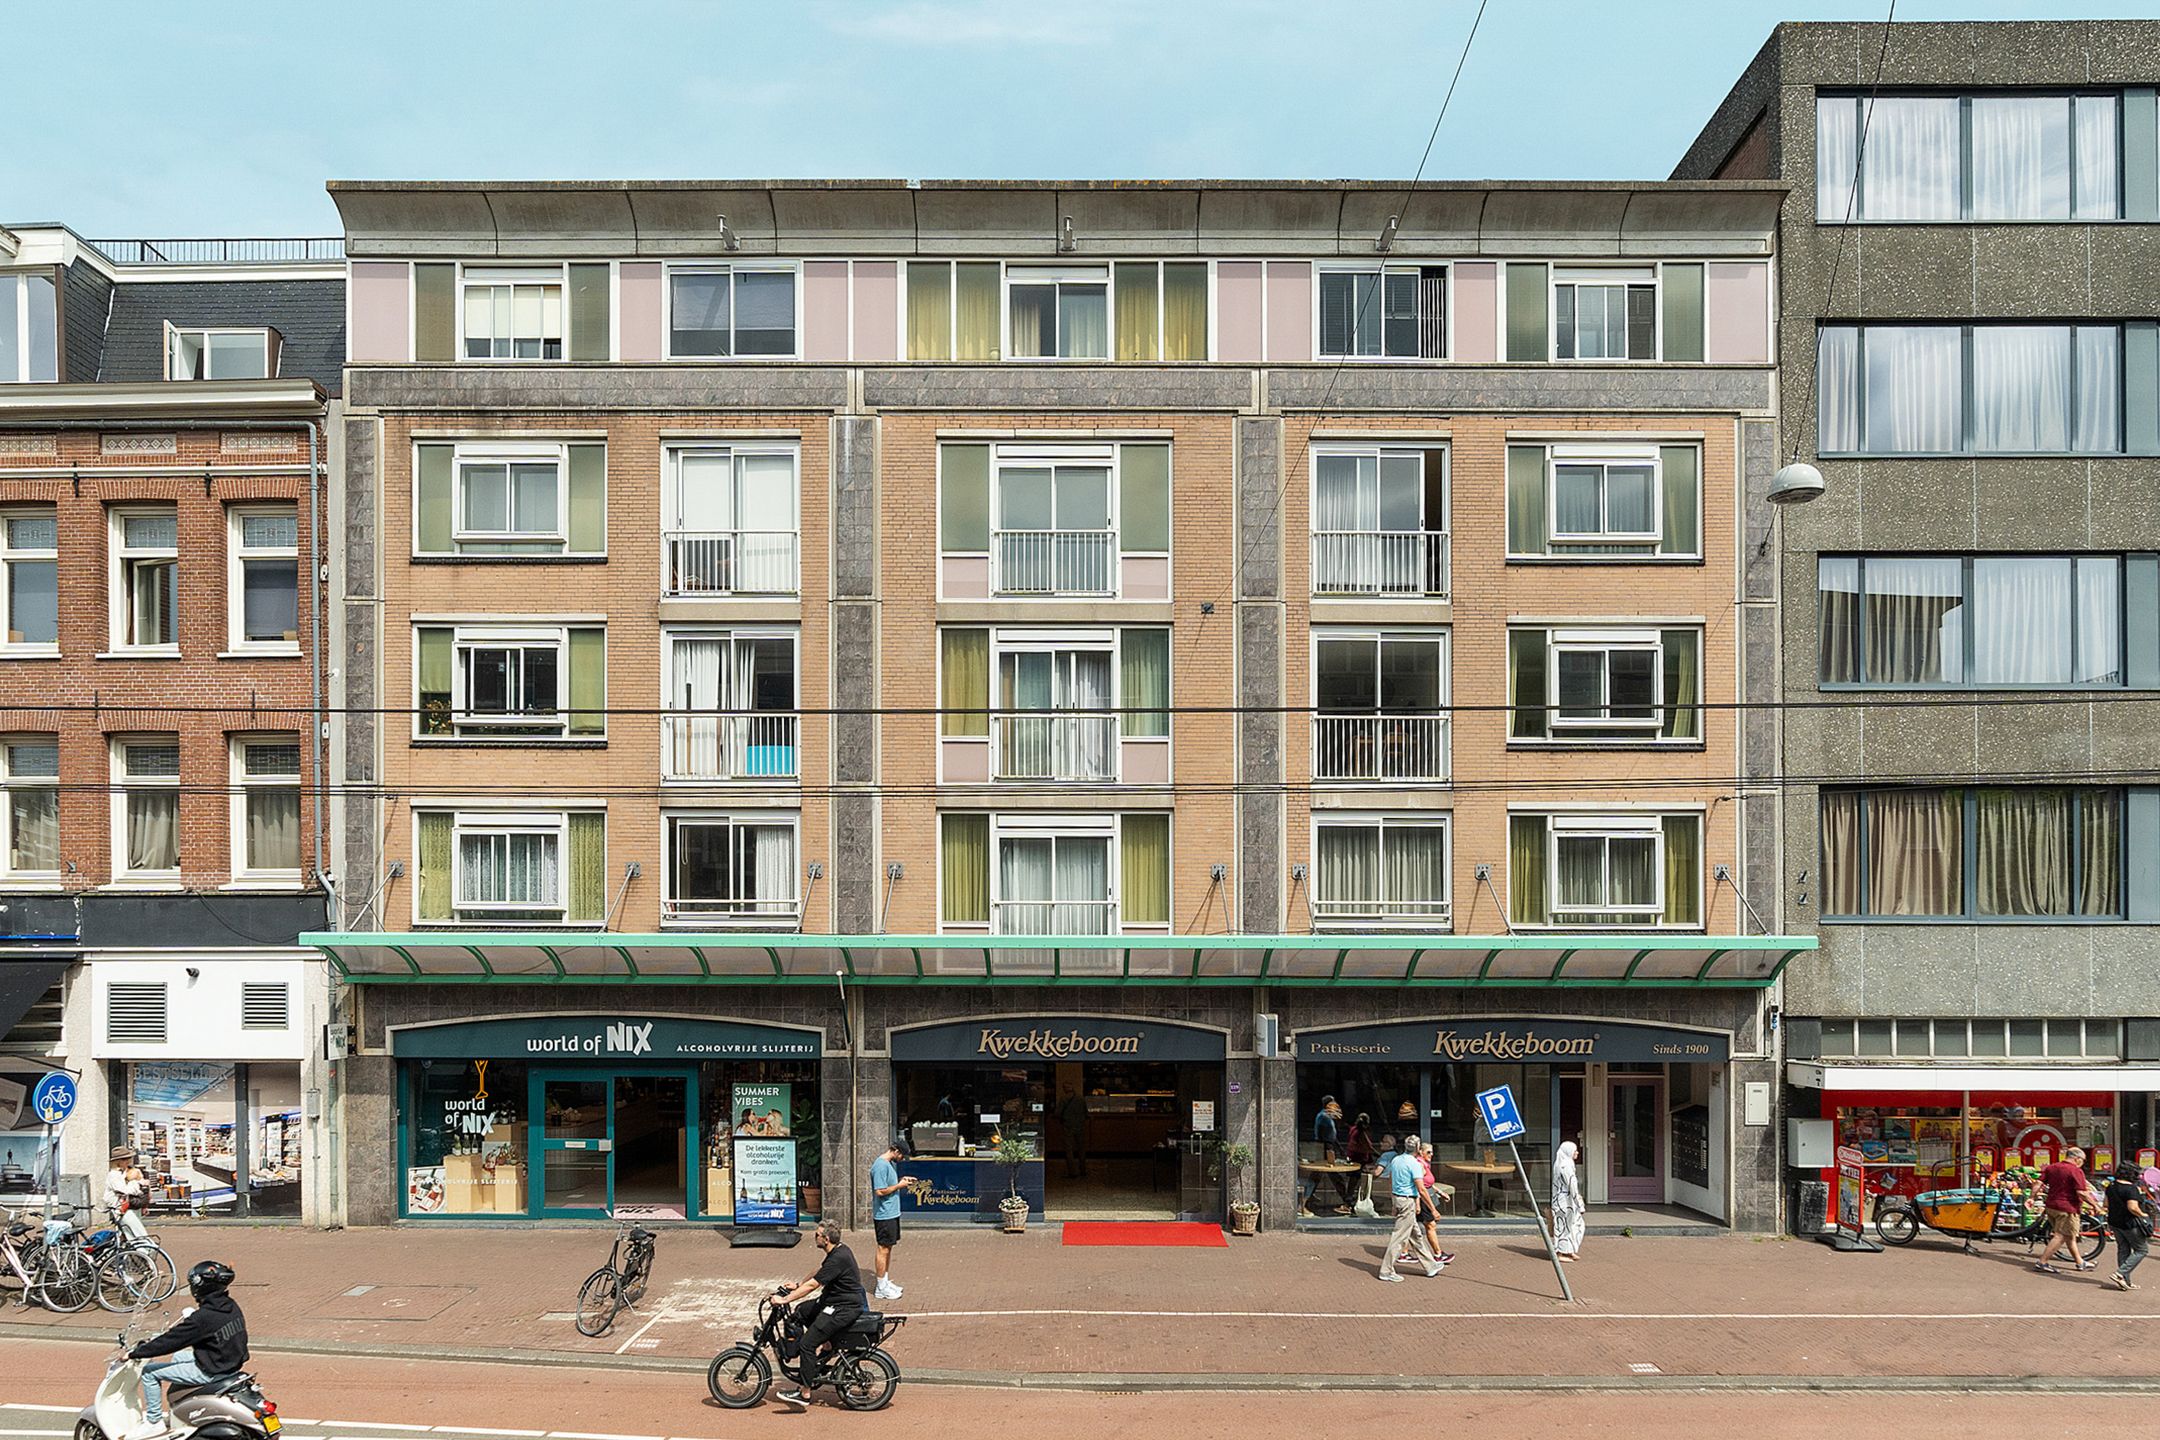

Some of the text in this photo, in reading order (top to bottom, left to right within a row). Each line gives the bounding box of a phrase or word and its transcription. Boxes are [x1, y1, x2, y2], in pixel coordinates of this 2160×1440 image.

[527, 1021, 653, 1056] world of NIX
[977, 1029, 1140, 1058] Kwekkeboom
[676, 1044, 814, 1053] ALCOHOLVRIJE SLIJTERIJ
[1310, 1043, 1391, 1054] Patisserie
[1432, 1030, 1595, 1060] Kwekkeboom
[1652, 1043, 1709, 1055] Sinds 1900
[734, 1087, 779, 1096] SUMMER
[445, 1098, 485, 1110] world
[734, 1097, 764, 1106] VIBES
[1485, 1093, 1506, 1120] P
[445, 1110, 498, 1136] of NIX
[923, 1194, 980, 1206] Kwekkeboom
